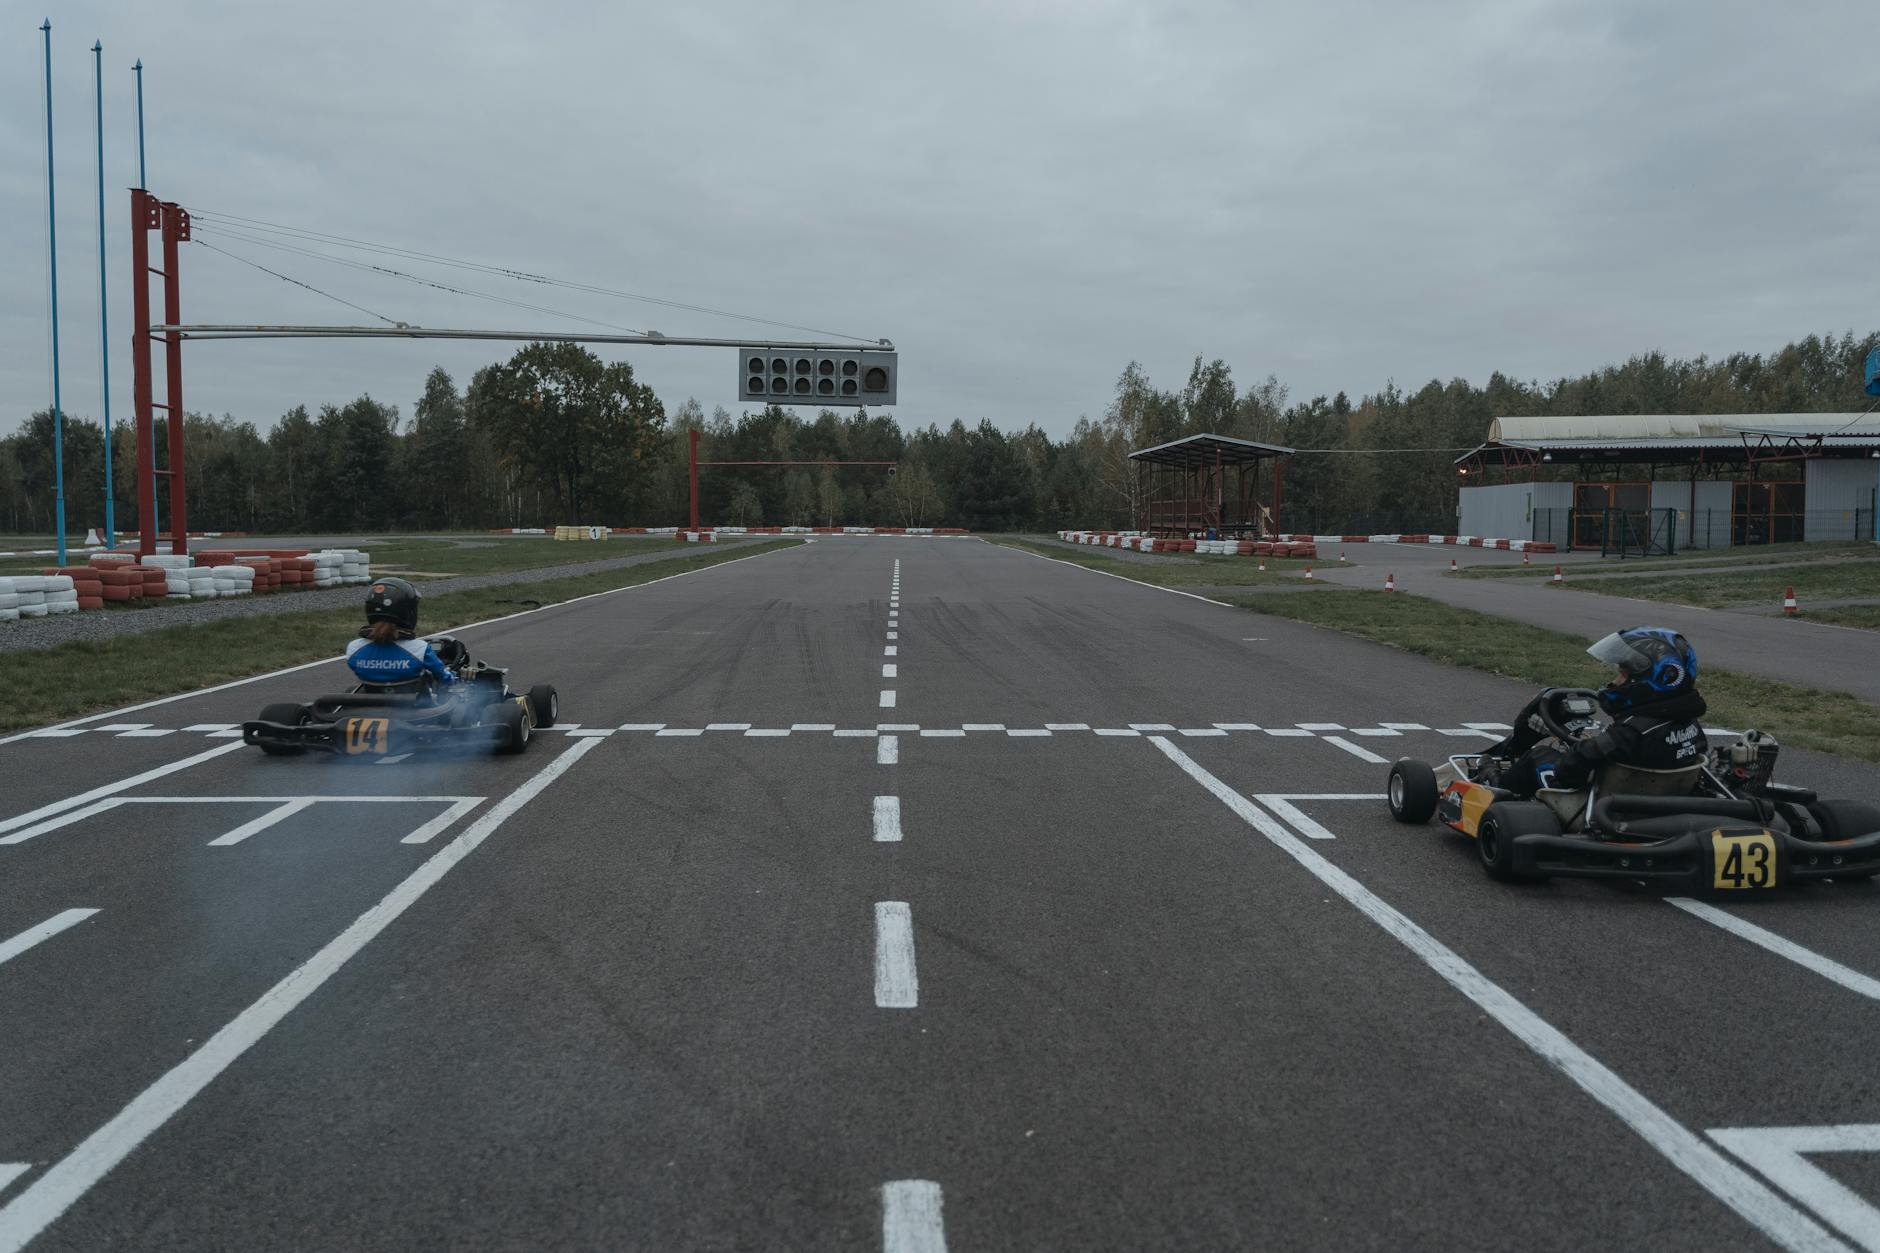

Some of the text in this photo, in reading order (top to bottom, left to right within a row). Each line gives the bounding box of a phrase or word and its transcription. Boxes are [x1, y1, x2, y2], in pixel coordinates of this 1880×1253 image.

[356, 659, 410, 670] HUSHCHYK
[351, 719, 381, 751] 14
[1721, 842, 1769, 888] 43
